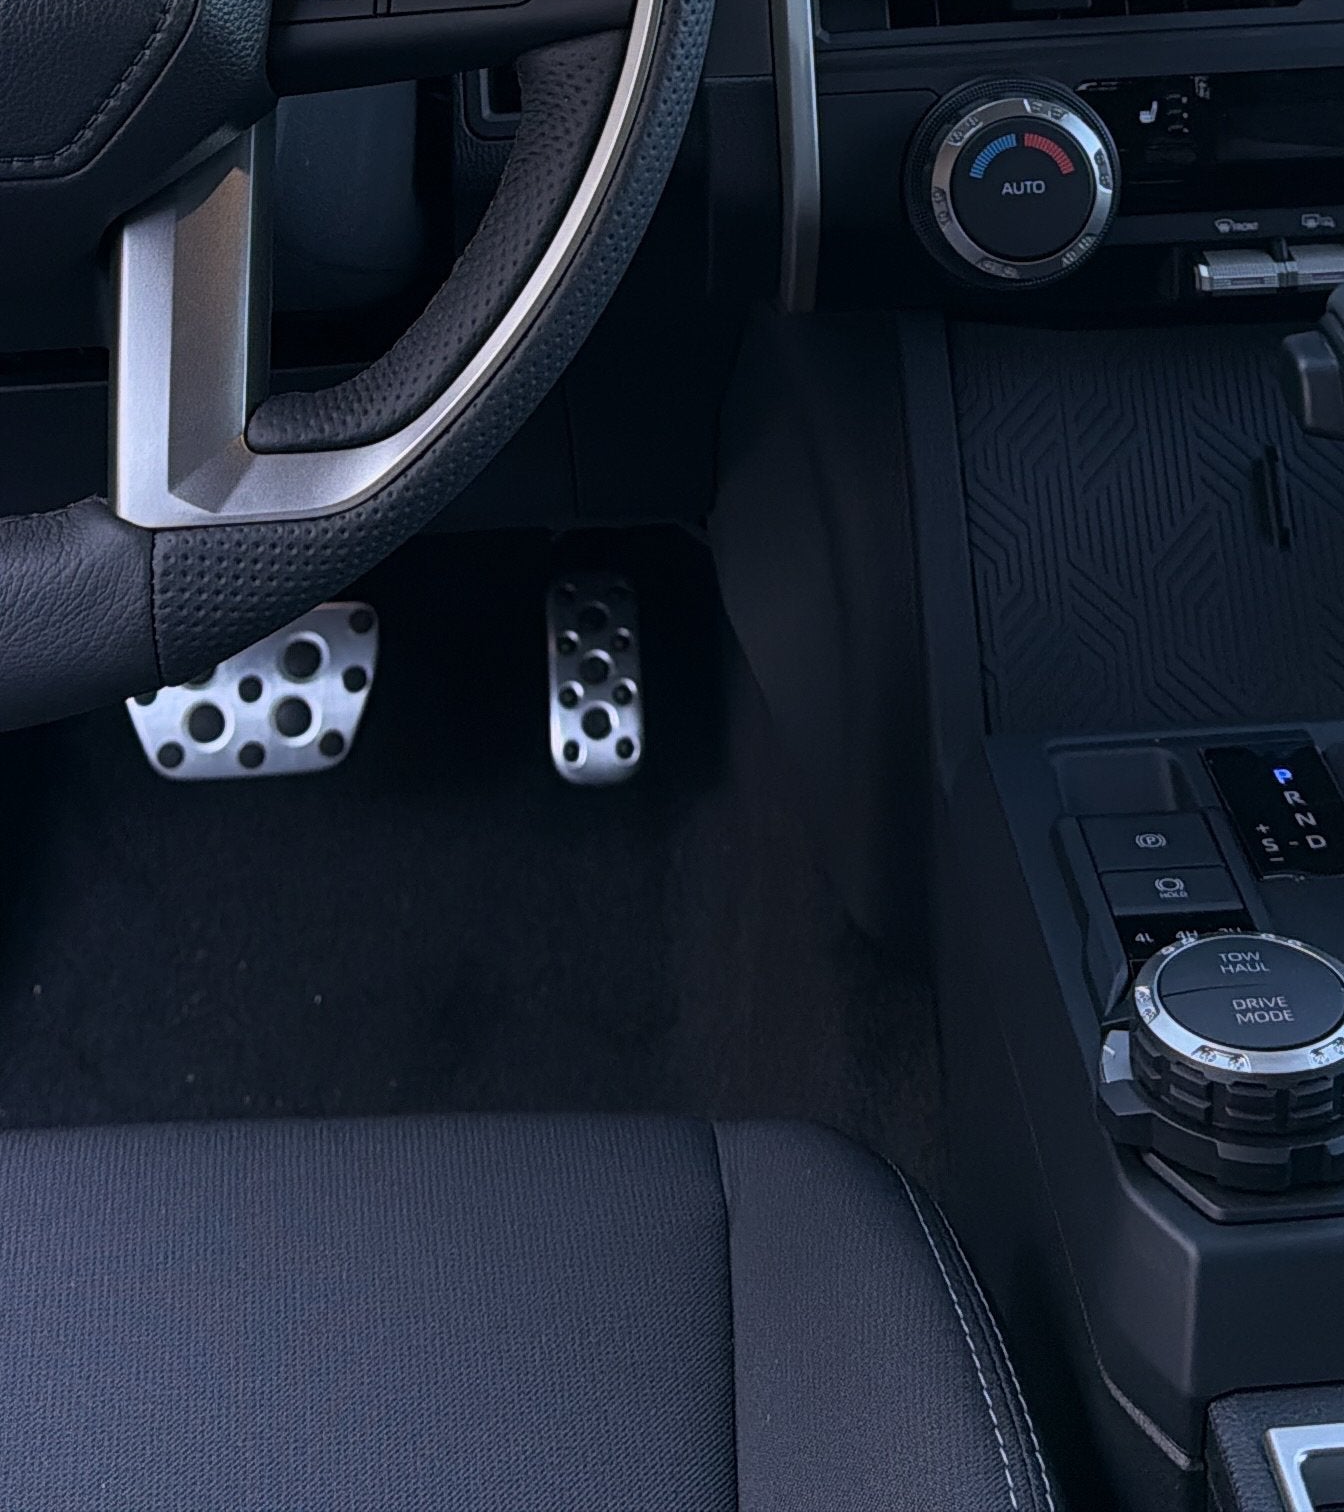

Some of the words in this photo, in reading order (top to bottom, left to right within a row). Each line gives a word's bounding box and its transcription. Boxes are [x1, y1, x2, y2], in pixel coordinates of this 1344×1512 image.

[1000, 179, 1046, 196] AUTO
[1273, 767, 1293, 785] P
[1283, 790, 1308, 806] R
[1294, 812, 1318, 828] N
[1261, 837, 1280, 852] S
[1305, 834, 1327, 849] D
[1134, 932, 1154, 946] 4L
[1218, 951, 1261, 963] TOW
[1219, 961, 1270, 975] HAUL
[1232, 995, 1289, 1011] DRIVE
[1235, 1009, 1296, 1025] MODE
